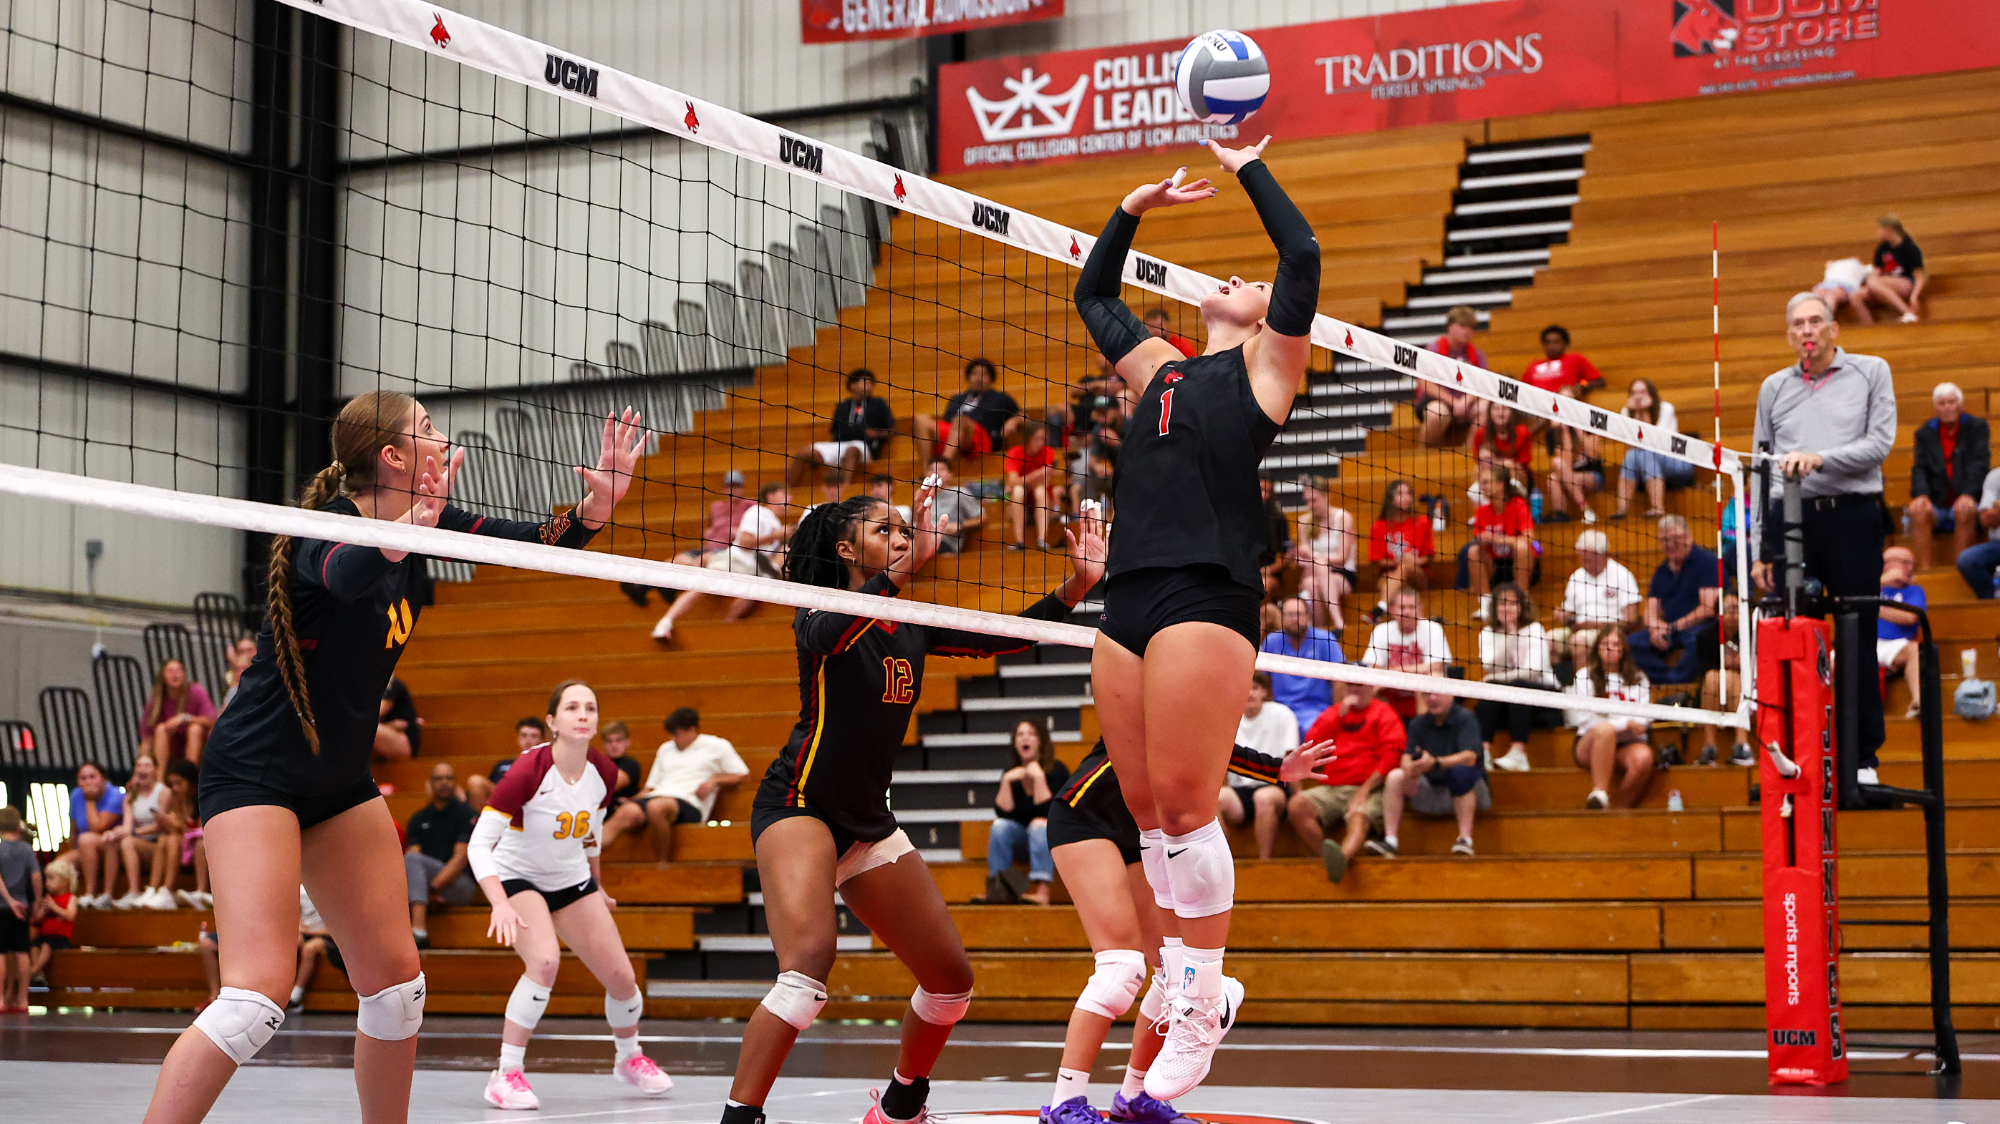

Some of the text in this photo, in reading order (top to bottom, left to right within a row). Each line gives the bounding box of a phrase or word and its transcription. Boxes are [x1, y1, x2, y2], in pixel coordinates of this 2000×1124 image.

[1745, 13, 1879, 51] STORE
[544, 52, 599, 99] UCM
[1093, 51, 1184, 90] COLLIS
[1315, 32, 1543, 95] TRADITIONS
[1093, 86, 1193, 130] LEADE
[779, 133, 823, 174] UCM
[964, 142, 1015, 165] OFFICIAL
[1017, 137, 1078, 160] COLLISION
[1080, 132, 1125, 155] CENTER
[1127, 129, 1143, 149] OF
[1175, 122, 1238, 144] ATHLETICS
[972, 200, 1010, 236] UCM
[1135, 256, 1166, 288] UCM
[1393, 344, 1418, 371] UCM
[1498, 378, 1519, 403] UCM
[1159, 387, 1175, 437] 1
[1590, 408, 1608, 432] UCM
[1670, 436, 1687, 456] UCM
[882, 656, 914, 704] 12
[553, 810, 590, 840] 36
[1782, 893, 1801, 1005] sports imports
[1771, 1028, 1817, 1047] UCM
